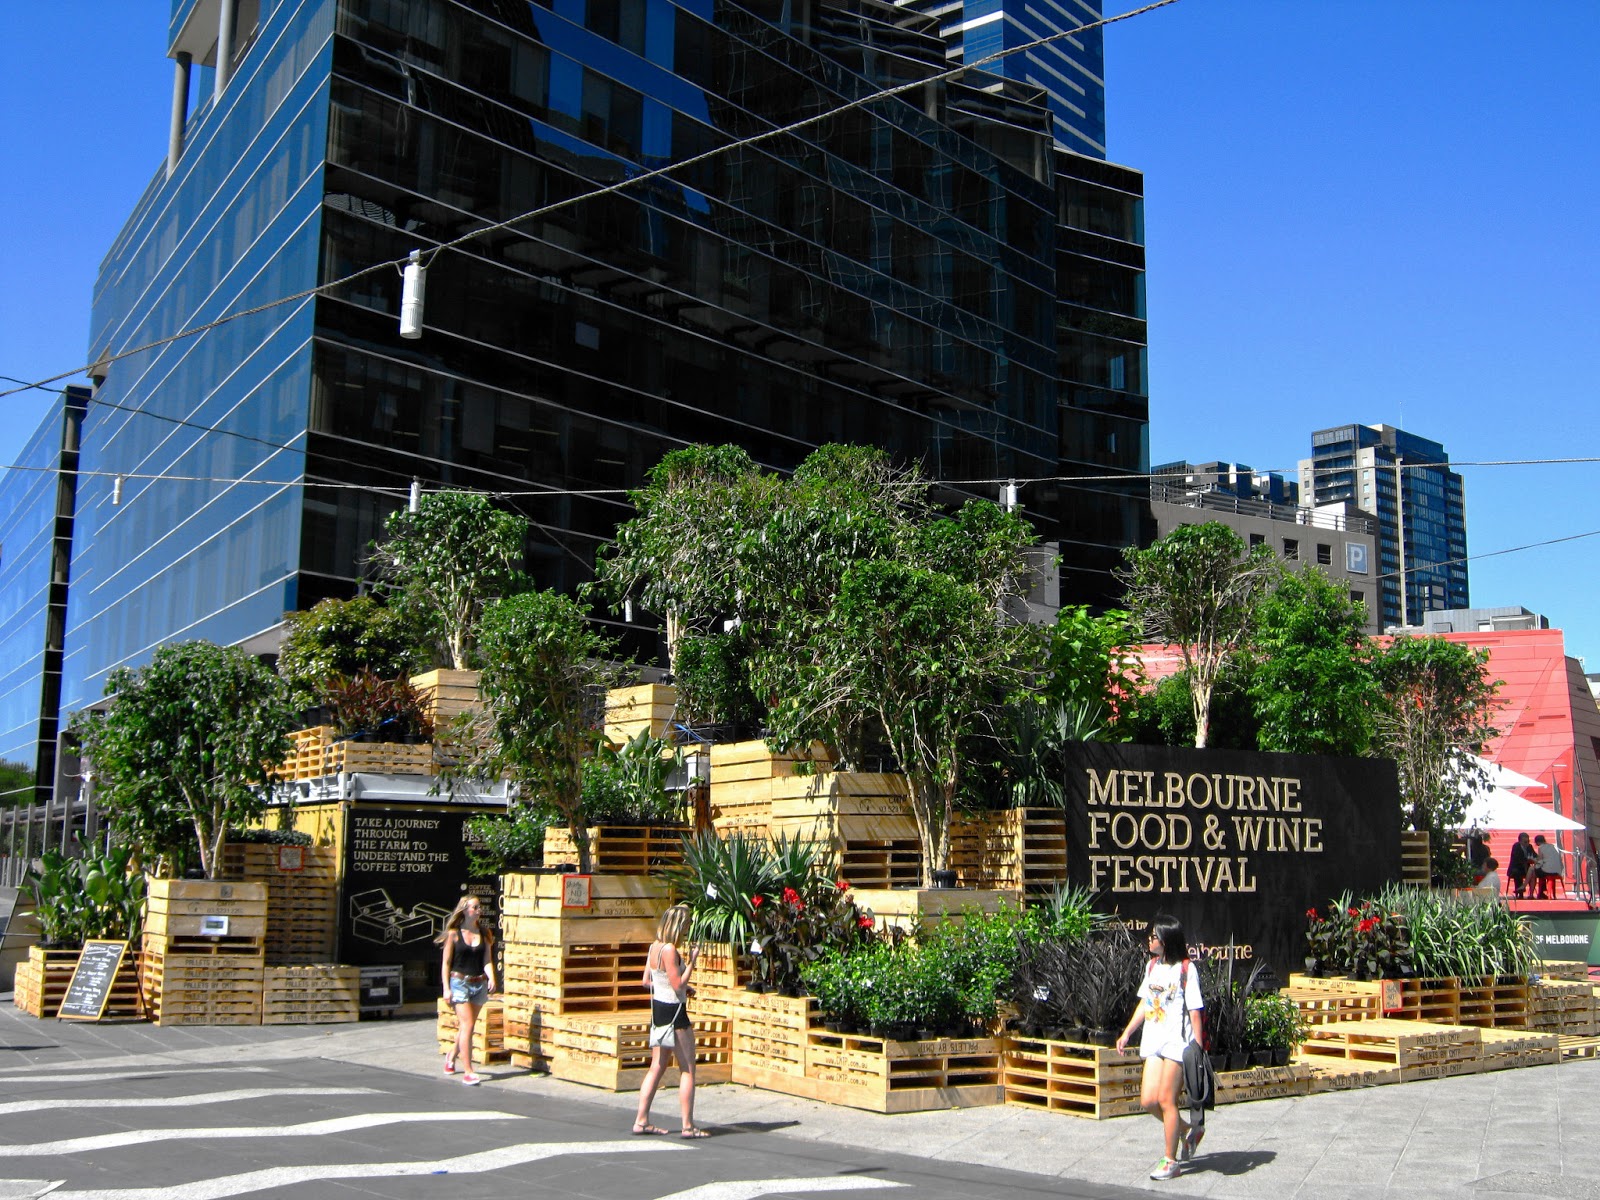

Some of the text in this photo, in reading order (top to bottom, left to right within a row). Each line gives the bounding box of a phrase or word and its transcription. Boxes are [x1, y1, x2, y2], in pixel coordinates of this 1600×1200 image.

[1350, 546, 1363, 569] P
[1086, 768, 1302, 812] MELBOURNE
[354, 817, 440, 829] TAKE A JOURNEY
[354, 828, 407, 839] THROUGH
[1088, 811, 1323, 852] FOOD & WINE
[354, 840, 428, 850] THE FARM TO
[353, 851, 449, 862] UNDERSTAND THE
[353, 862, 434, 873] COFFEE STORY
[1088, 855, 1256, 893] FESTIVAL
[1545, 934, 1590, 944] MELBOURNE
[1416, 1033, 1460, 1045] PALLETS BY CMTP
[1502, 1042, 1543, 1051] www.CMTP.com.au
[1417, 1049, 1461, 1061] PALLETS BY CMTP
[825, 1056, 868, 1069] www.CMTP.com.au
[1504, 1056, 1544, 1067] www.CMTP.com.au
[1418, 1065, 1462, 1077] PALLETS BY CMTP
[825, 1073, 868, 1087] www.CMTP.com.au
[1328, 1074, 1377, 1087] PALLETS BY CMTP
[1235, 1087, 1288, 1100] www.CMTP.com.au
